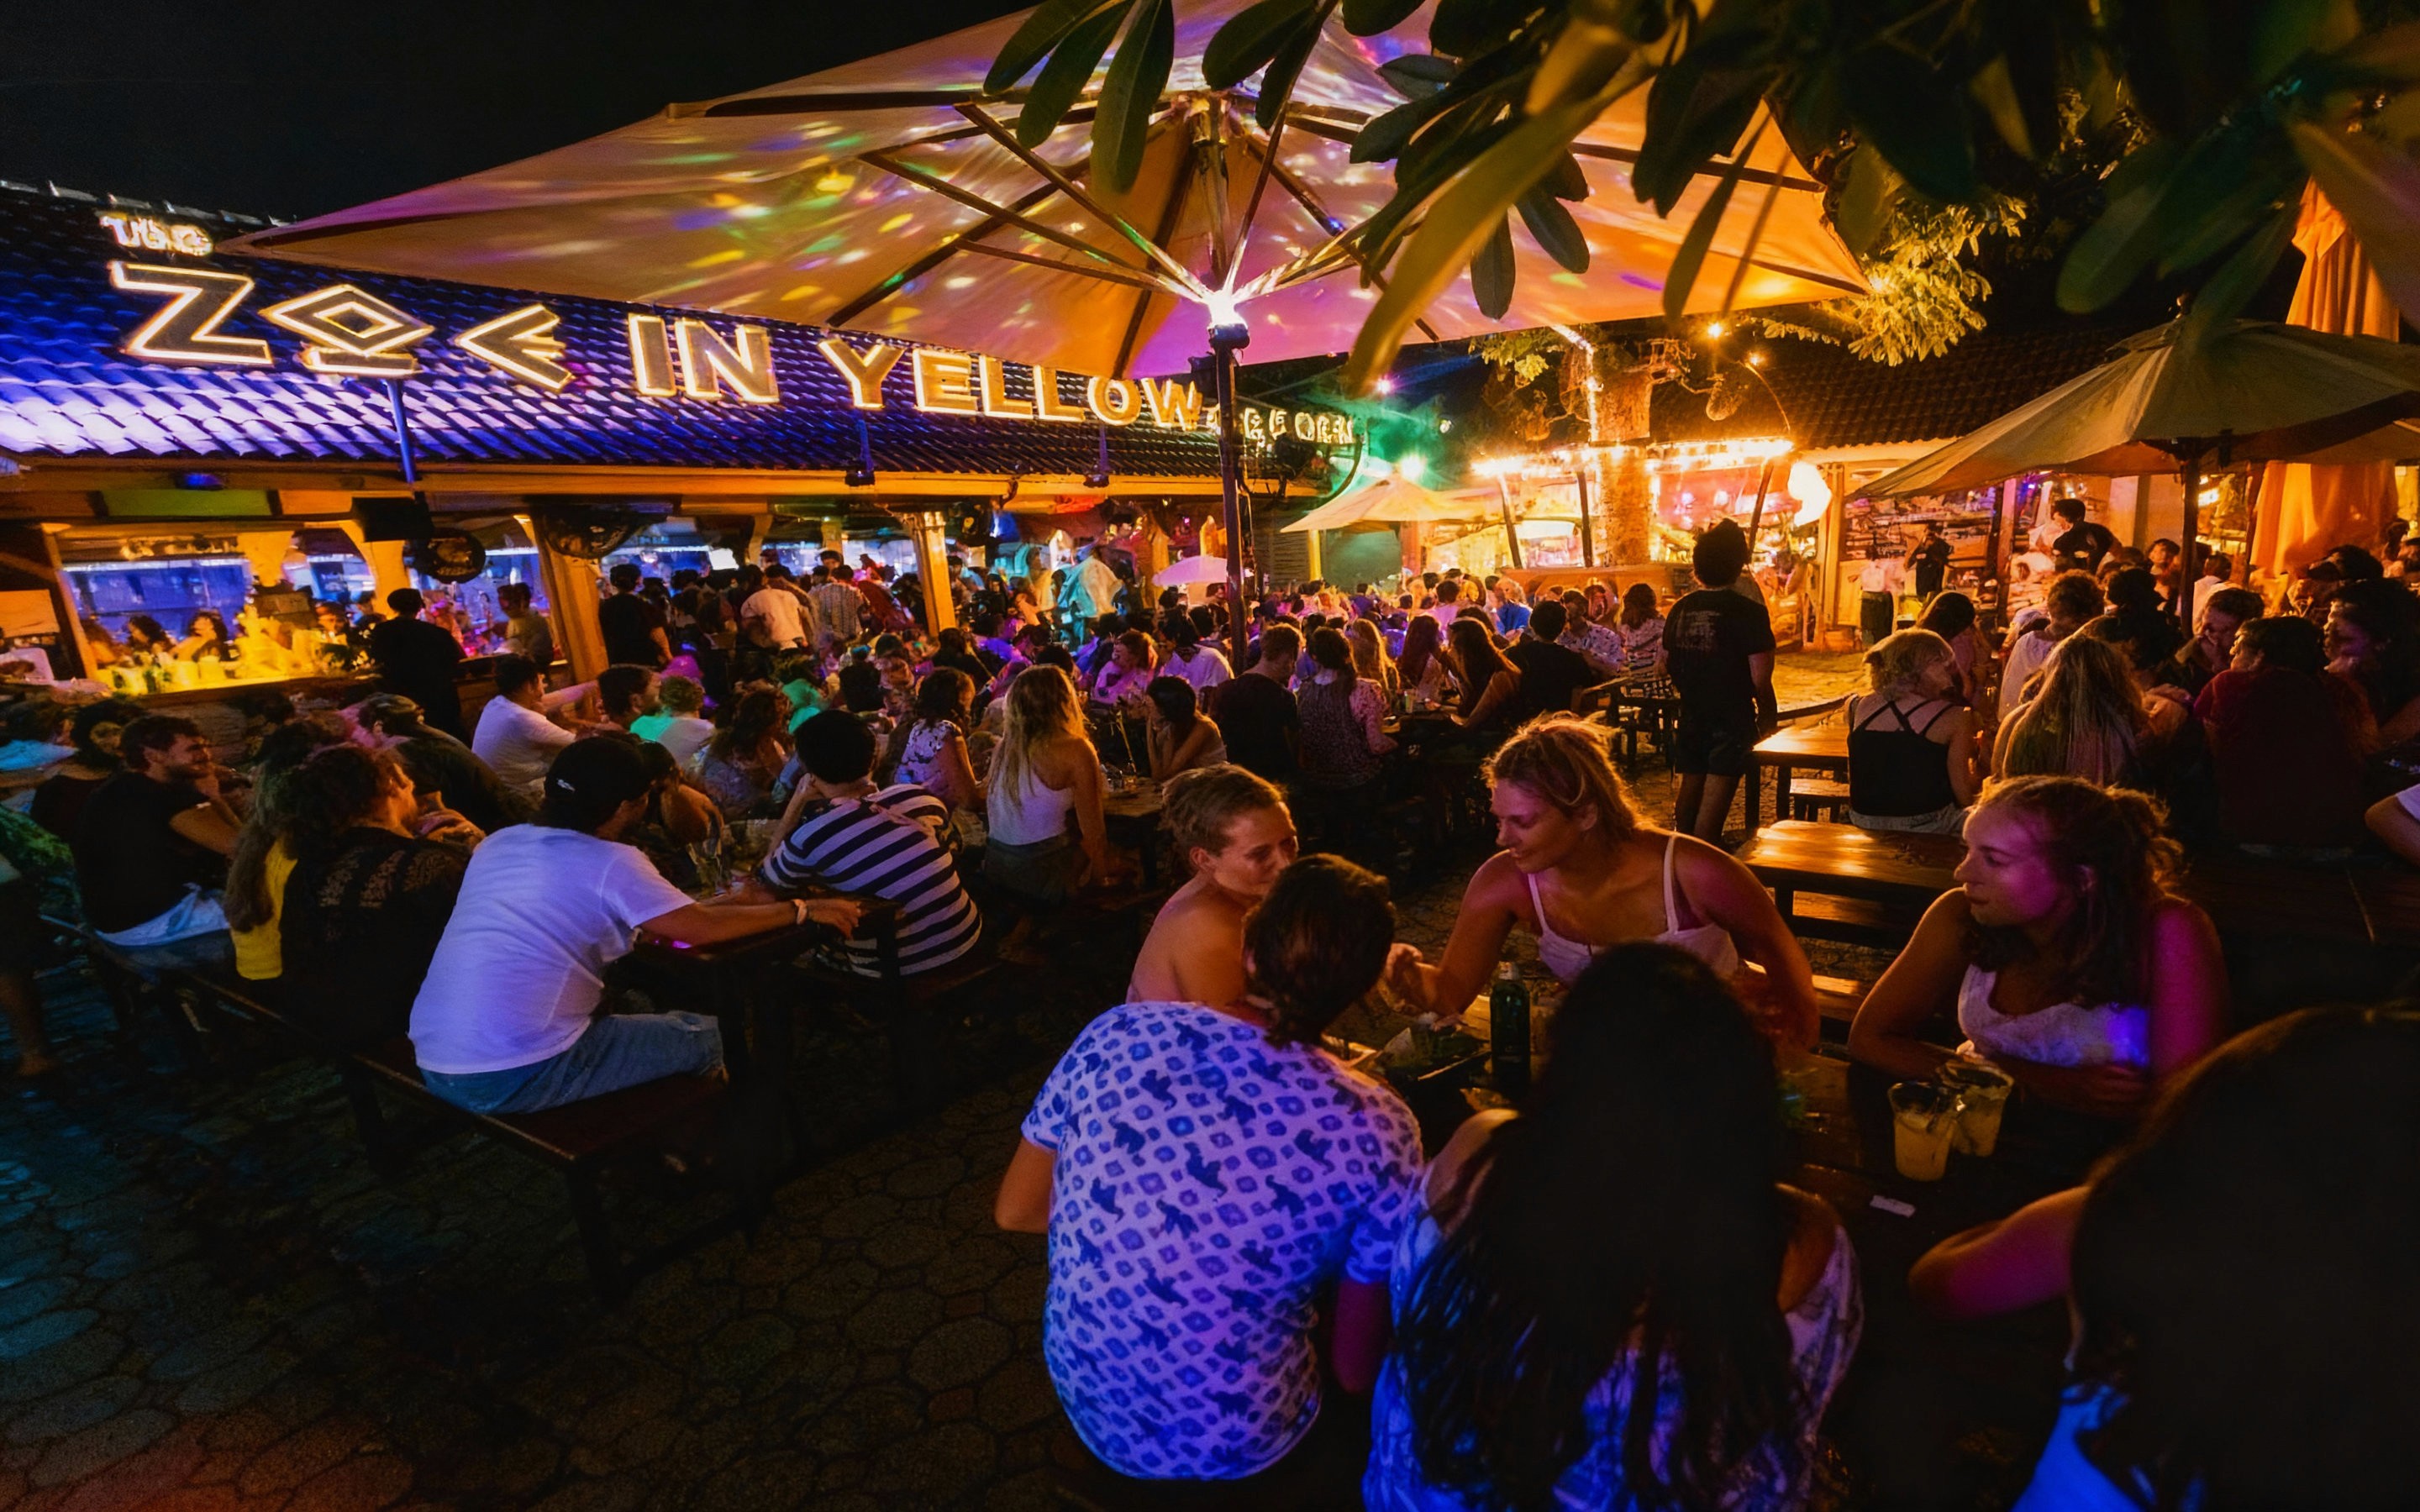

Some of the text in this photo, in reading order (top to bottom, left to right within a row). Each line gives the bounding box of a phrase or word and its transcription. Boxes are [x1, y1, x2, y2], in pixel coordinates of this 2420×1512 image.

[109, 260, 575, 392] ZOE
[628, 312, 780, 405] IN
[818, 336, 1203, 432] YELLOW
